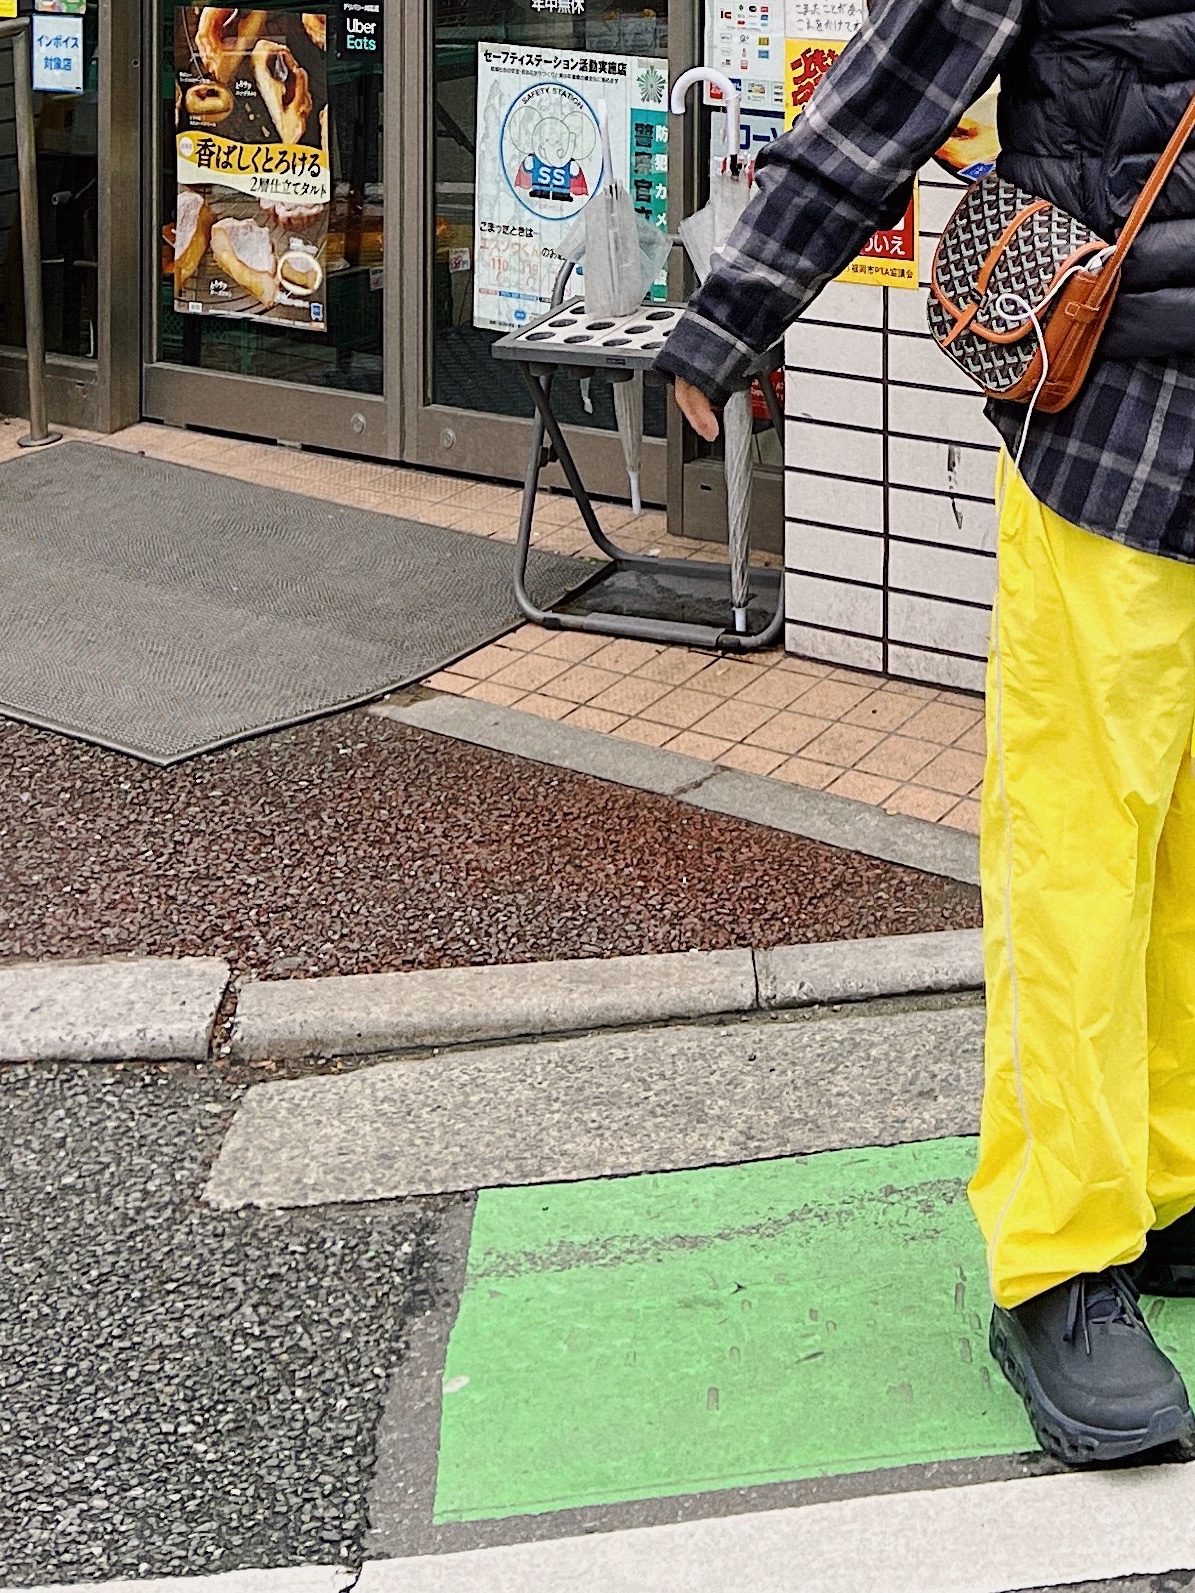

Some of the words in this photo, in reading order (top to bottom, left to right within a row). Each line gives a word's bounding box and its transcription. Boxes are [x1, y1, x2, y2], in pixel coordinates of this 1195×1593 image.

[346, 17, 377, 35] Uber
[346, 34, 377, 51] Eats
[43, 57, 73, 72] 対象店
[483, 50, 628, 77] セーフティステーション活動実施店
[521, 87, 551, 105] SAFETY
[551, 87, 584, 110] STATION
[195, 137, 321, 178] 香ばしくとろける
[537, 166, 566, 186] SS
[250, 176, 327, 199] 2層仕立てタルト
